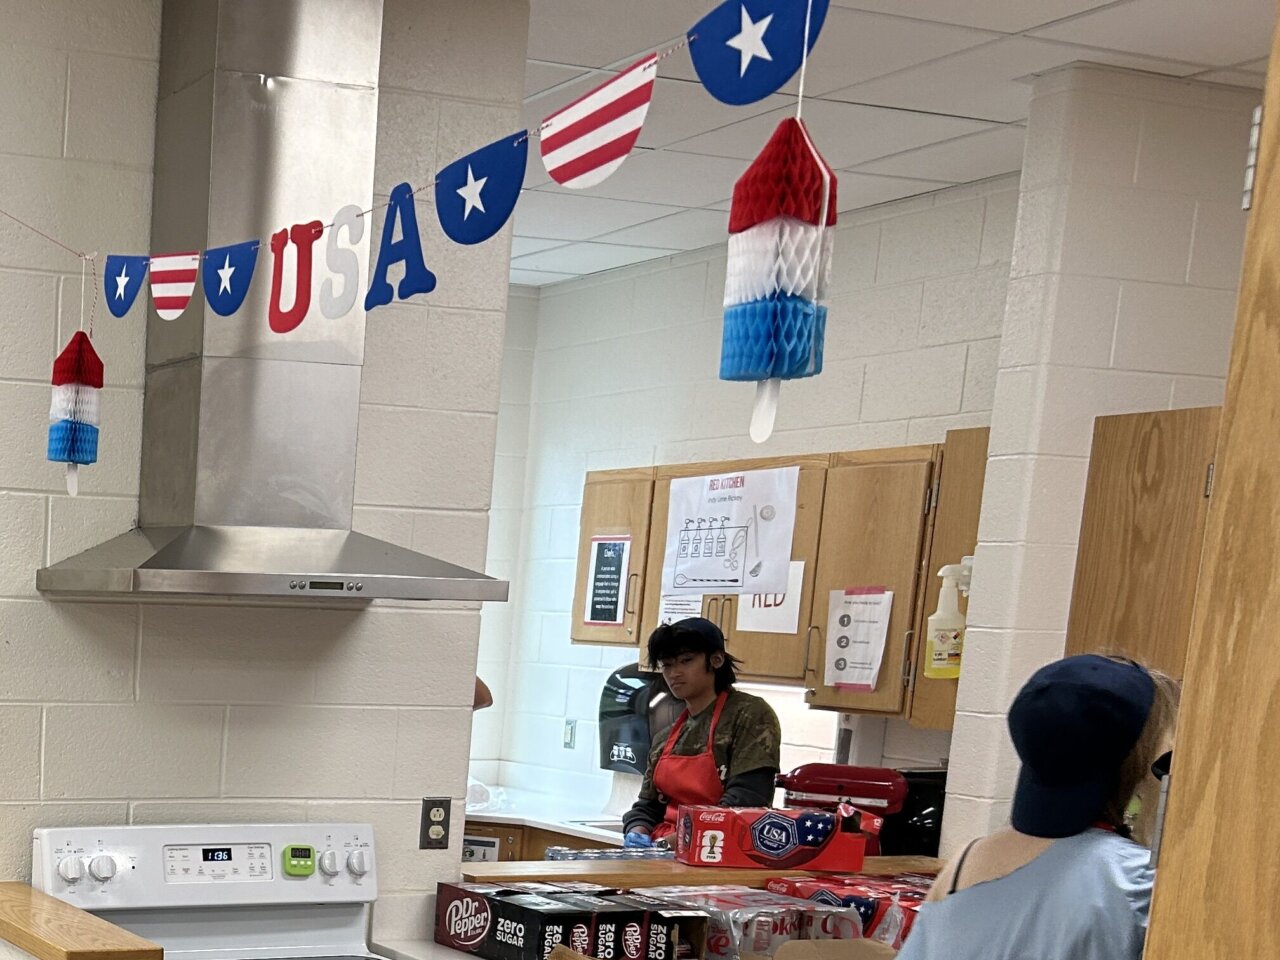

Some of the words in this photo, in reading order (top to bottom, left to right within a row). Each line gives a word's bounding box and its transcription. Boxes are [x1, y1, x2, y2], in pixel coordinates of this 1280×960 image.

[269, 182, 437, 334] USA
[709, 479, 720, 491] RED
[720, 475, 745, 490] KITCHEN
[699, 811, 726, 822] Coca-Cola
[763, 824, 786, 843] USA
[767, 880, 788, 892] Coca-Cola
[462, 898, 478, 918] Dr
[449, 899, 488, 938] Pepper
[497, 918, 525, 938] zero
[496, 930, 524, 948] SUGAR
[552, 925, 563, 948] ze
[597, 924, 606, 959] SUGAR
[624, 926, 640, 956] Pepper
[648, 924, 657, 959] SUGAR
